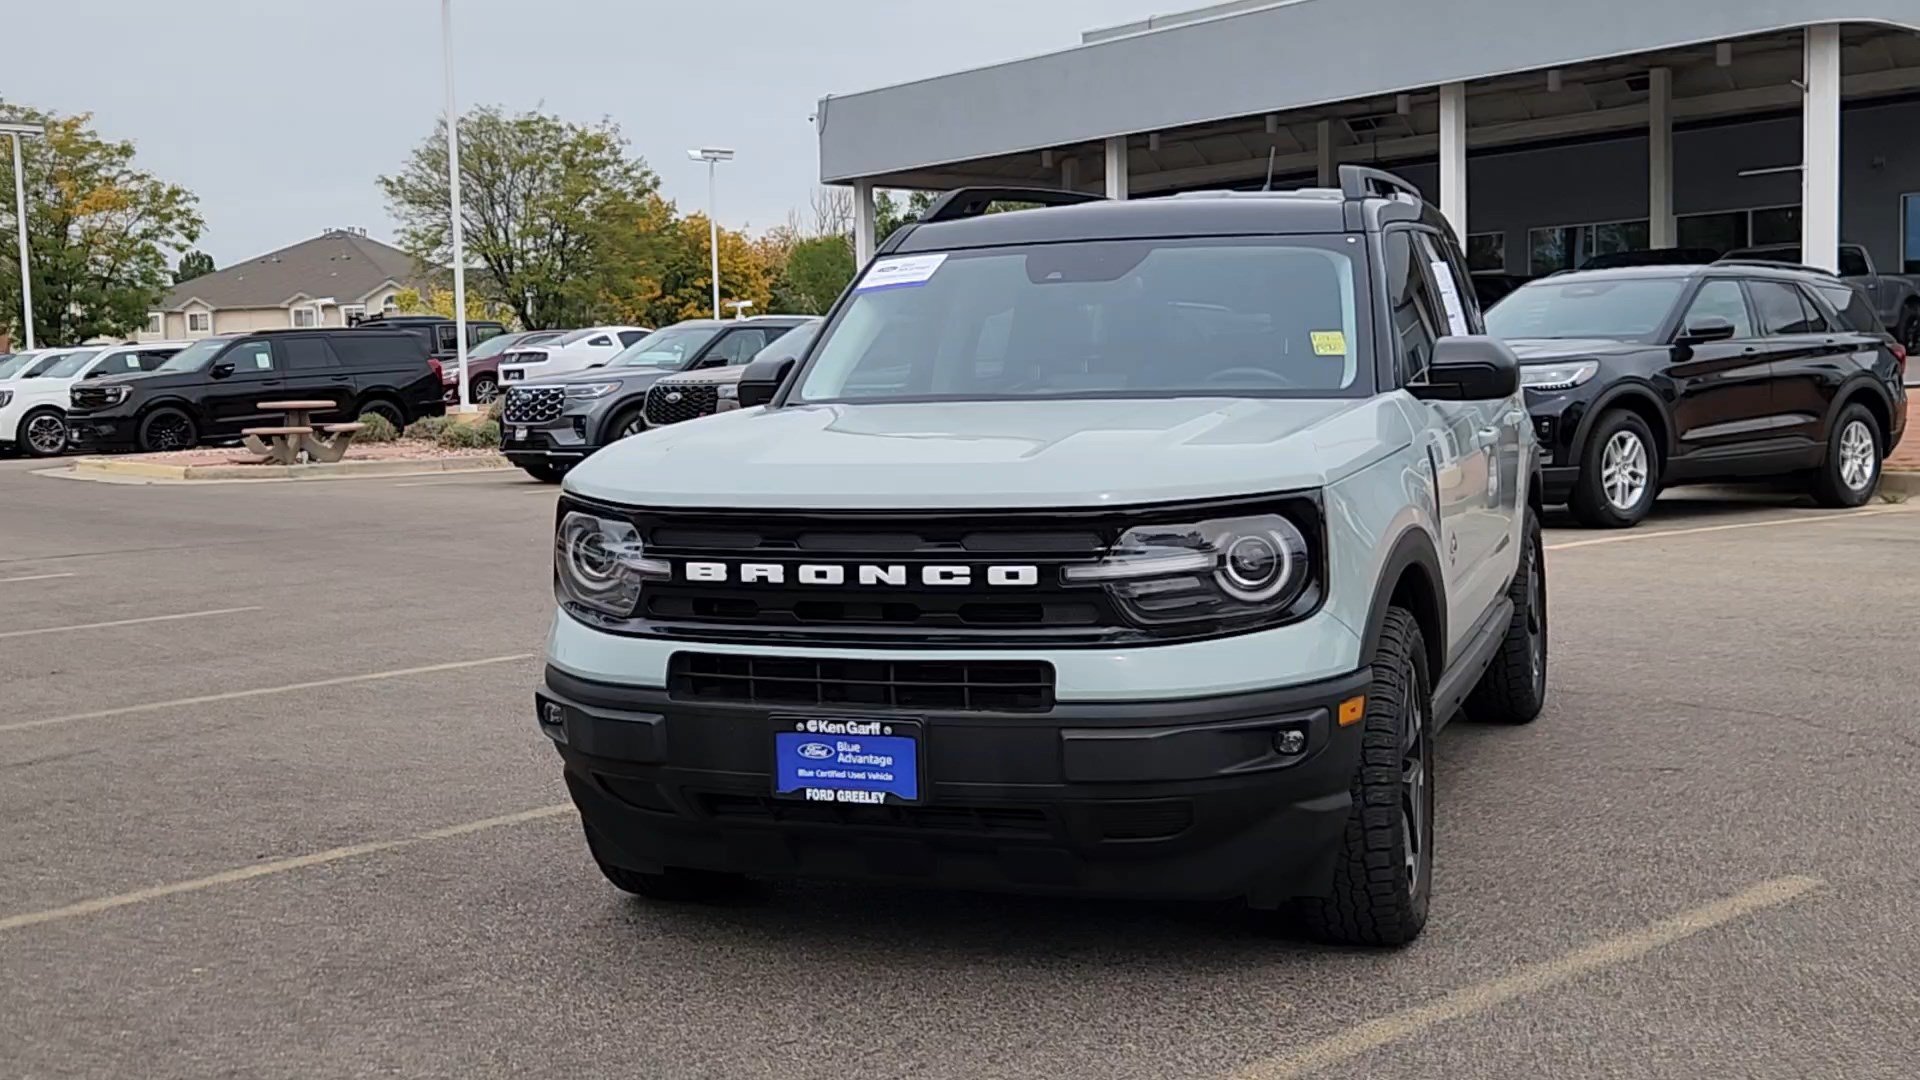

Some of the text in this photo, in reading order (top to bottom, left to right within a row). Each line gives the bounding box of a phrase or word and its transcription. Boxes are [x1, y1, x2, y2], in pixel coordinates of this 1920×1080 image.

[686, 562, 1038, 585] BRONCO
[818, 720, 881, 735] Ken Garff
[836, 741, 861, 752] Blue
[837, 753, 893, 767] Advantage
[797, 768, 893, 781] Blue Certified Used Vehicle
[805, 788, 886, 804] FORD GREELEY
